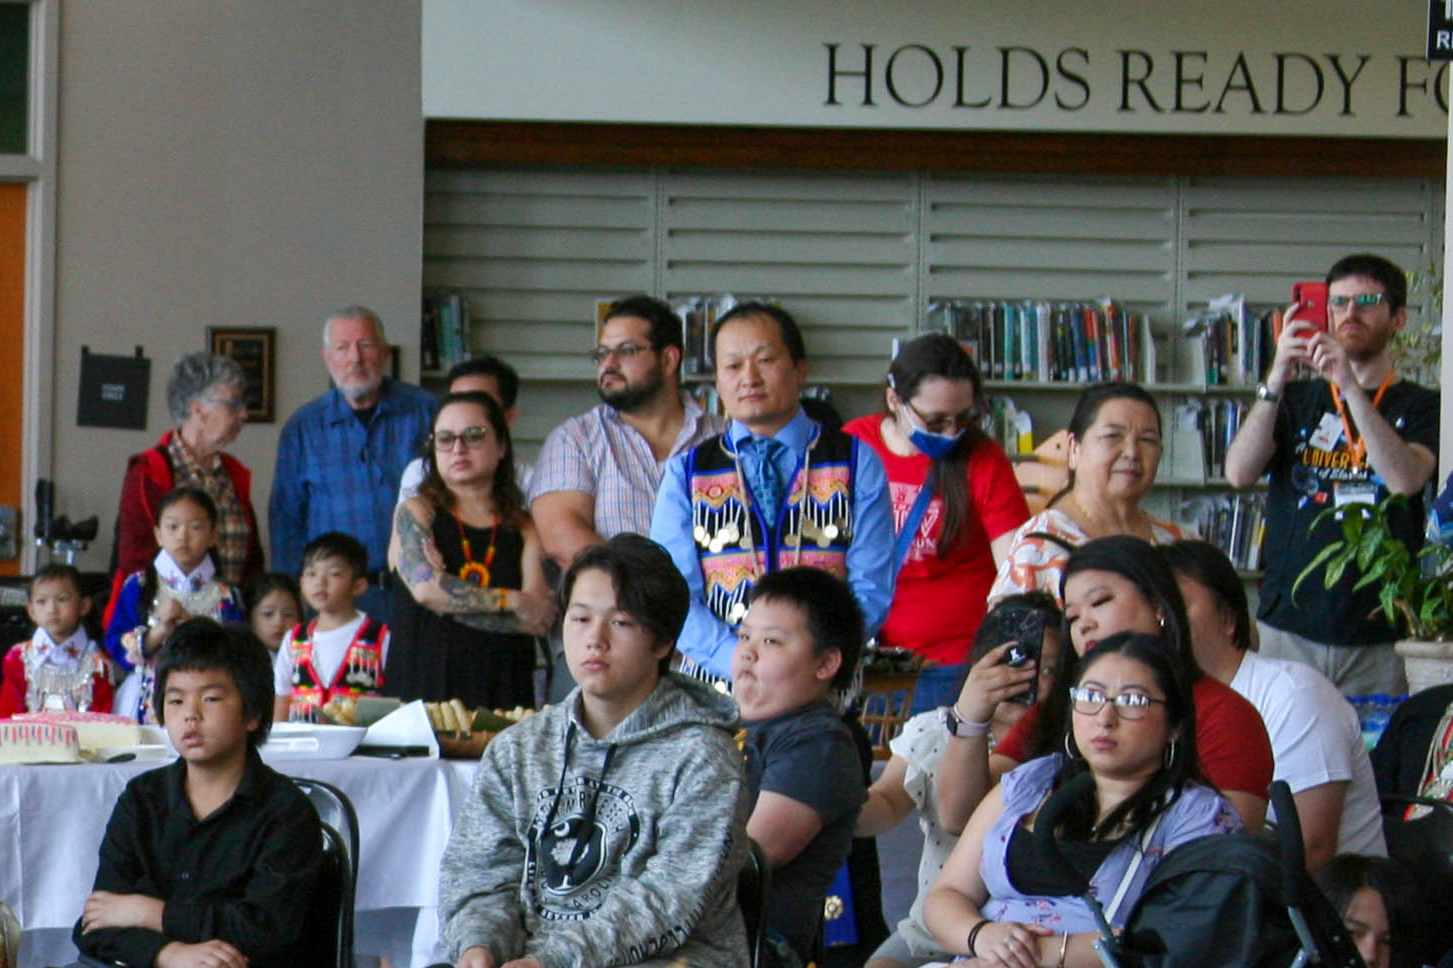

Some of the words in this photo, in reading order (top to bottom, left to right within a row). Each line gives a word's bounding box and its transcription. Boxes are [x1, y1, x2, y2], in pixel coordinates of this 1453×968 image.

[823, 43, 1091, 110] HOLDS
[1117, 50, 1371, 117] READY
[1395, 54, 1451, 117] F
